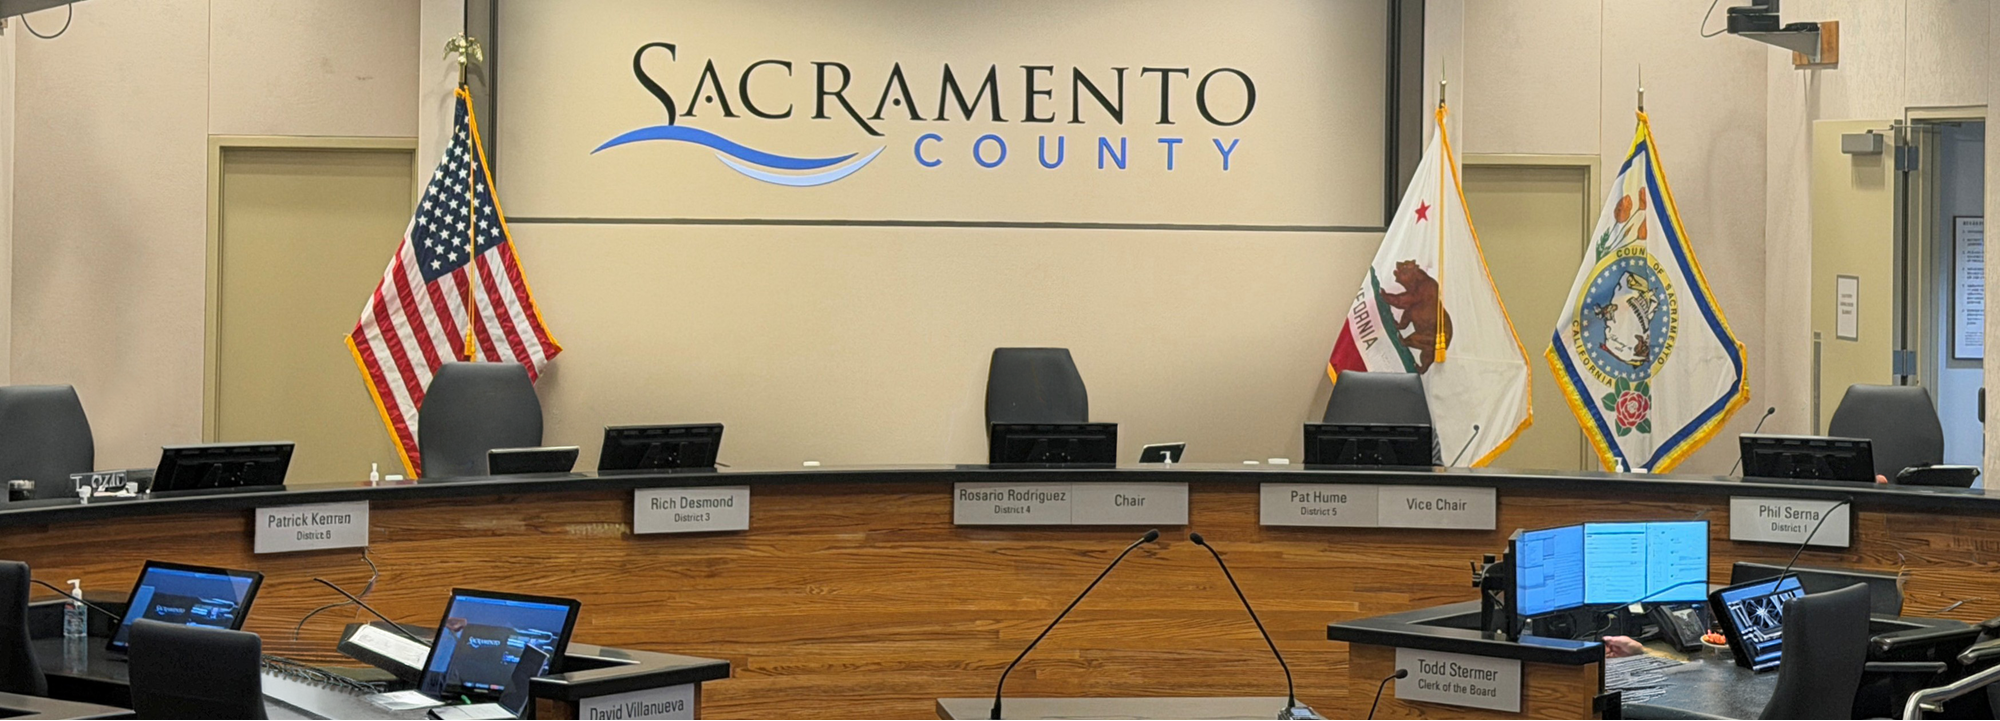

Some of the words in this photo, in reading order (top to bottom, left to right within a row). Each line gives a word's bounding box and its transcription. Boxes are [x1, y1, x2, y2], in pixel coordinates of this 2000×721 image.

[632, 41, 1257, 137] SACRAMENTO
[913, 132, 1241, 171] COUNTY
[1616, 247, 1645, 259] COUN
[1652, 262, 1664, 276] OF
[1353, 288, 1378, 351] FORNIA
[1657, 283, 1678, 366] SACRAMENTO
[1572, 319, 1613, 389] CALIFORNIA
[650, 497, 676, 511] Rich
[680, 495, 734, 510] Desmond
[959, 489, 1004, 502] Rosario
[1007, 489, 1067, 504] Rodriguez
[1114, 494, 1146, 507] Chair
[1290, 490, 1310, 503] Pat
[1313, 491, 1348, 504] Hume
[994, 505, 1024, 514] District
[1025, 505, 1031, 514] 4
[1300, 507, 1331, 516] District
[1331, 508, 1338, 517] 5
[1406, 497, 1433, 511] Vice
[1435, 498, 1468, 512] Chair
[268, 512, 309, 529] Patrick
[674, 512, 704, 523] District
[704, 512, 711, 522] 3
[1759, 505, 1781, 519] Phil
[1784, 506, 1820, 521] Serna
[1771, 522, 1801, 533] District
[1803, 524, 1808, 533] 1
[296, 530, 325, 541] District
[1418, 659, 1446, 676] Todd
[1449, 662, 1498, 681] Stermer
[1418, 678, 1441, 691] Clerk
[1442, 682, 1452, 693] of
[1453, 683, 1467, 694] the
[1469, 684, 1497, 698] Board
[590, 704, 622, 720] David
[626, 699, 684, 719] Villanueva
